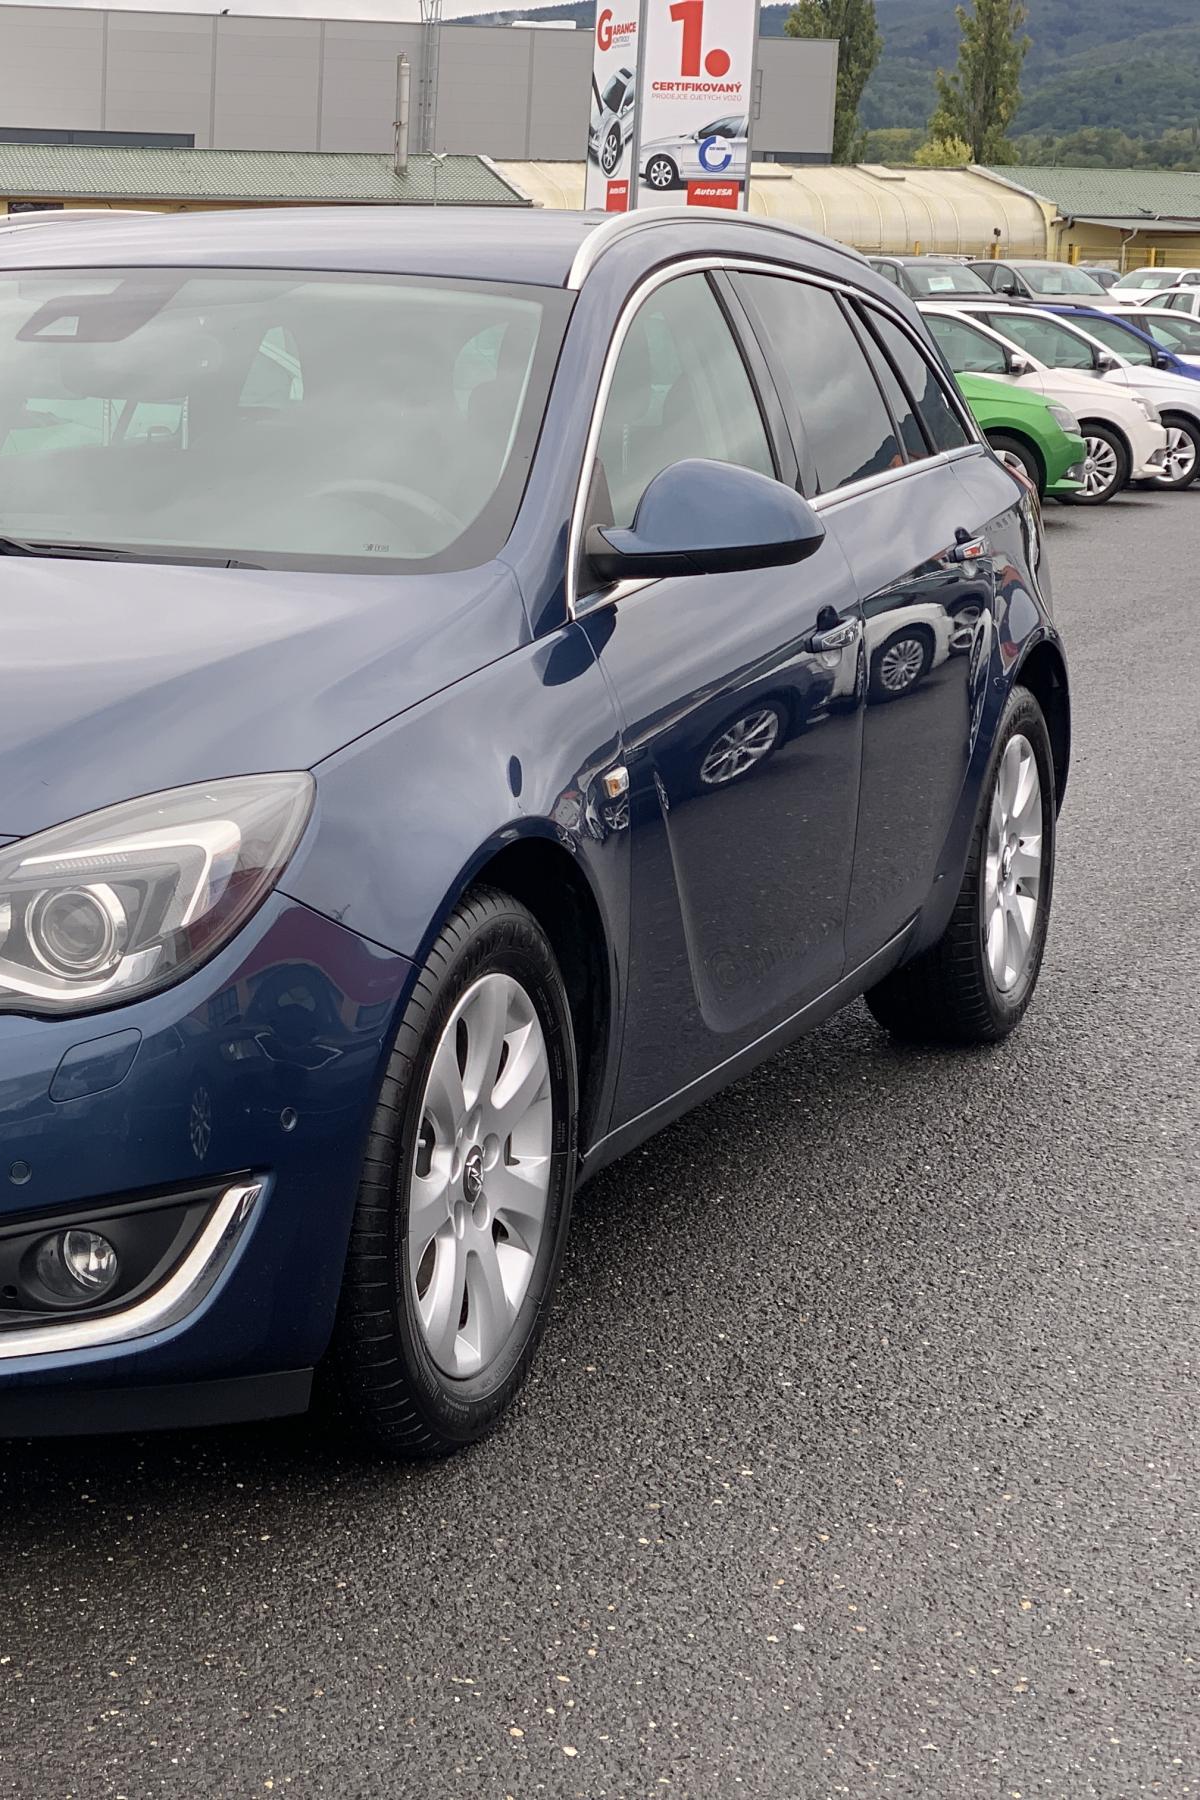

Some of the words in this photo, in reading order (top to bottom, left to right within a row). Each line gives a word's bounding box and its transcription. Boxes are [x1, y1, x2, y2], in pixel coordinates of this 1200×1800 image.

[597, 9, 637, 51] GARANCE
[670, 1, 731, 77] 1.
[652, 81, 742, 93] CERTIFIKOVANÝ
